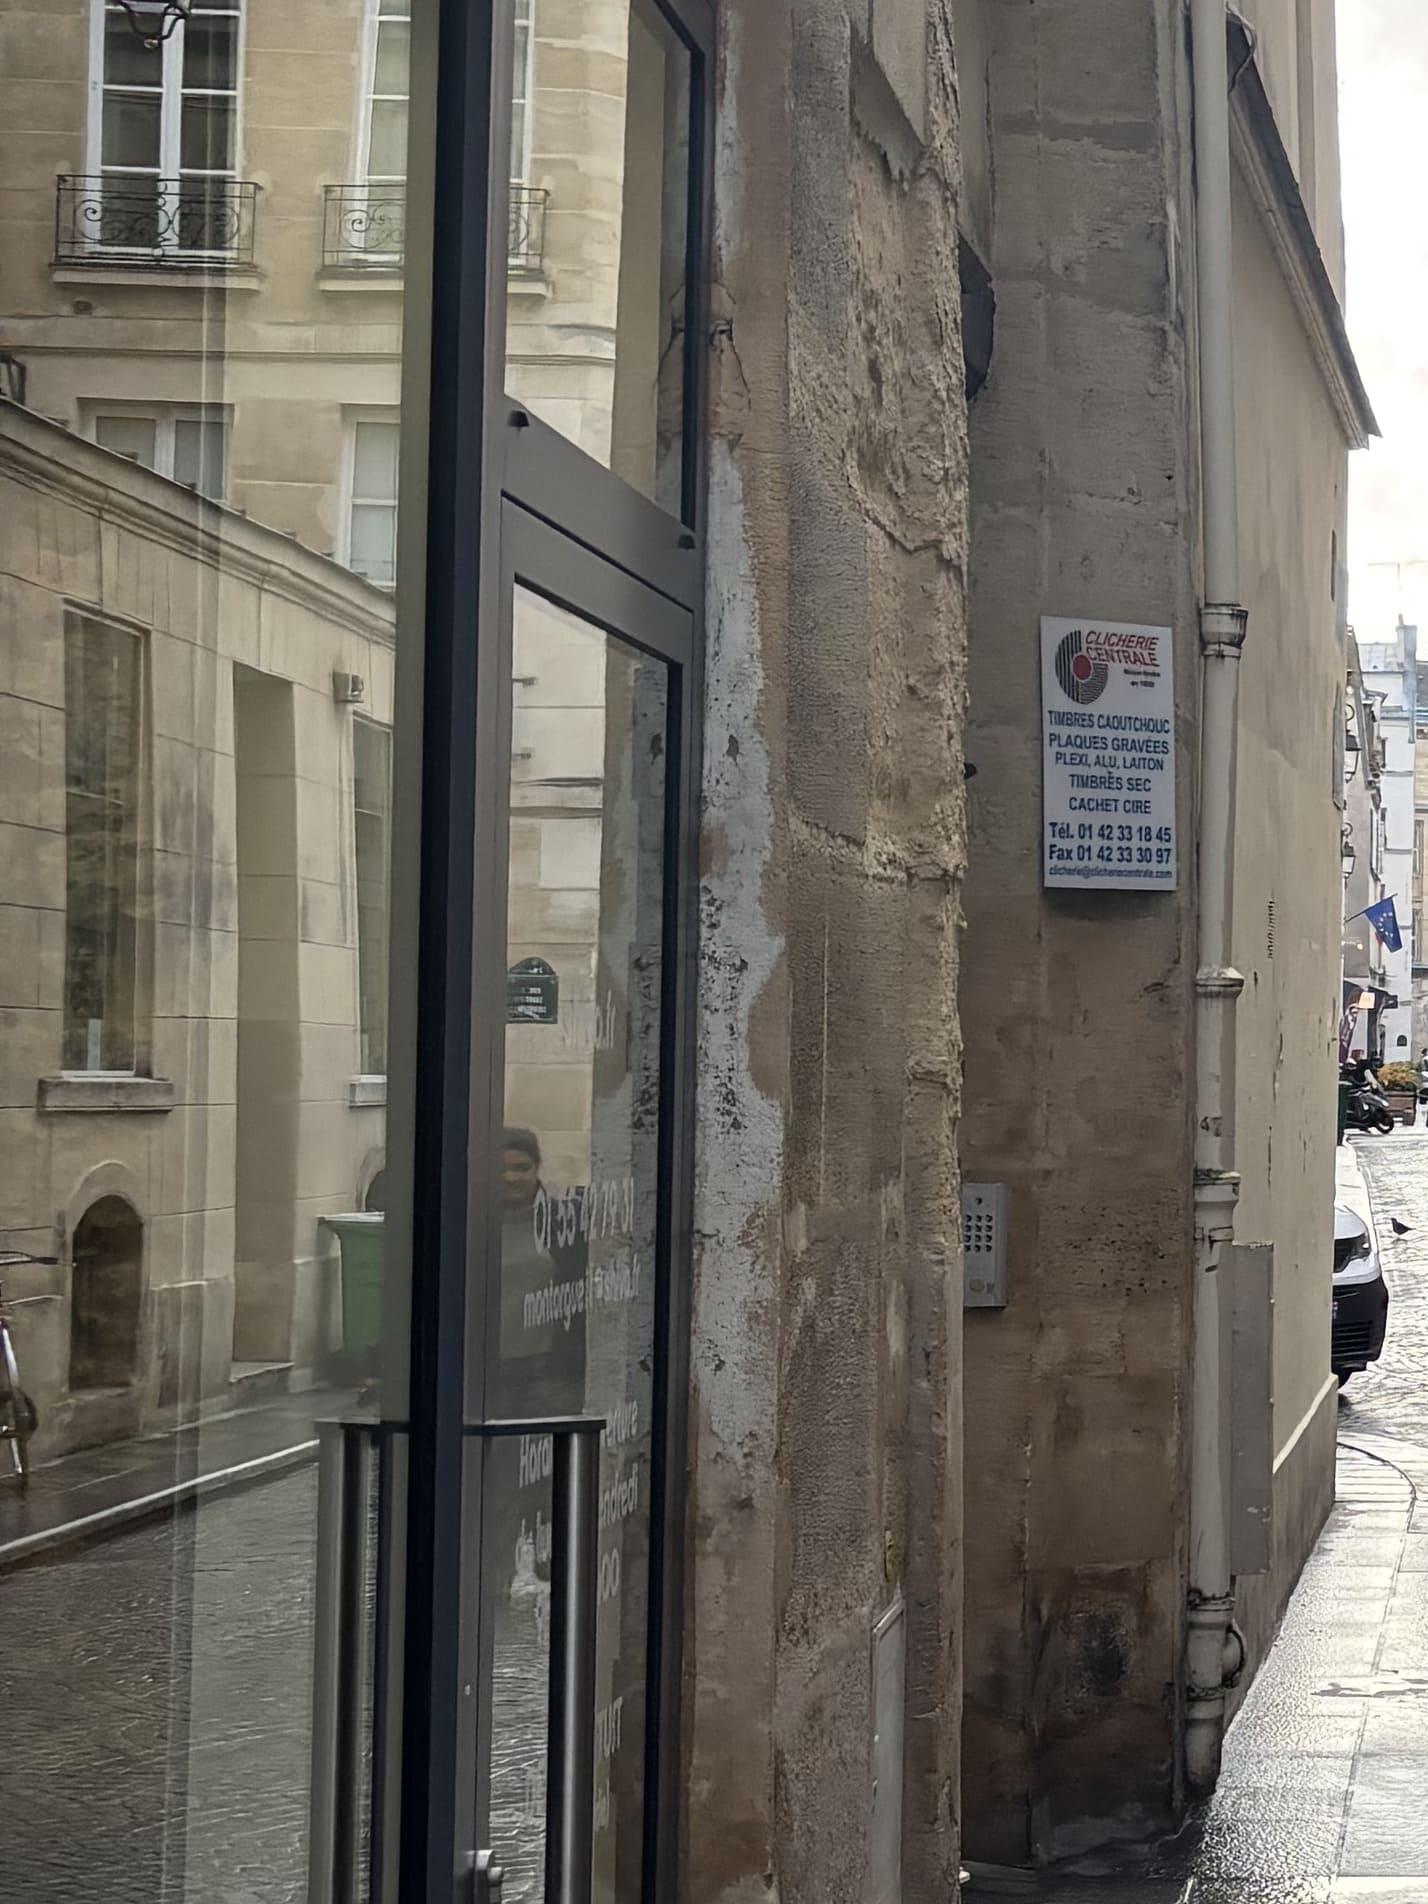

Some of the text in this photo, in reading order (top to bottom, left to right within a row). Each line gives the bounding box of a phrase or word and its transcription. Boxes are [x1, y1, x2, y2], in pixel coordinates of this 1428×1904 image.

[1085, 630, 1160, 651] CLICHERIE
[1086, 646, 1160, 667] CENTRALE
[1048, 710, 1170, 734] TIMBRES CAOUTCHOUC
[1049, 733, 1169, 755] PLAQUES GRAVÉES
[1123, 756, 1164, 771] LAITON
[1126, 777, 1151, 792] SEC
[1069, 796, 1151, 814] CACHET CIRE
[1048, 822, 1171, 843] Tél. 01 42 33 18 45
[1048, 844, 1171, 865] Fax 01 42 33 30 97
[534, 1186, 552, 1256] 01
[580, 1180, 598, 1243] 42
[601, 1179, 618, 1240] 79
[621, 1176, 635, 1234] 31
